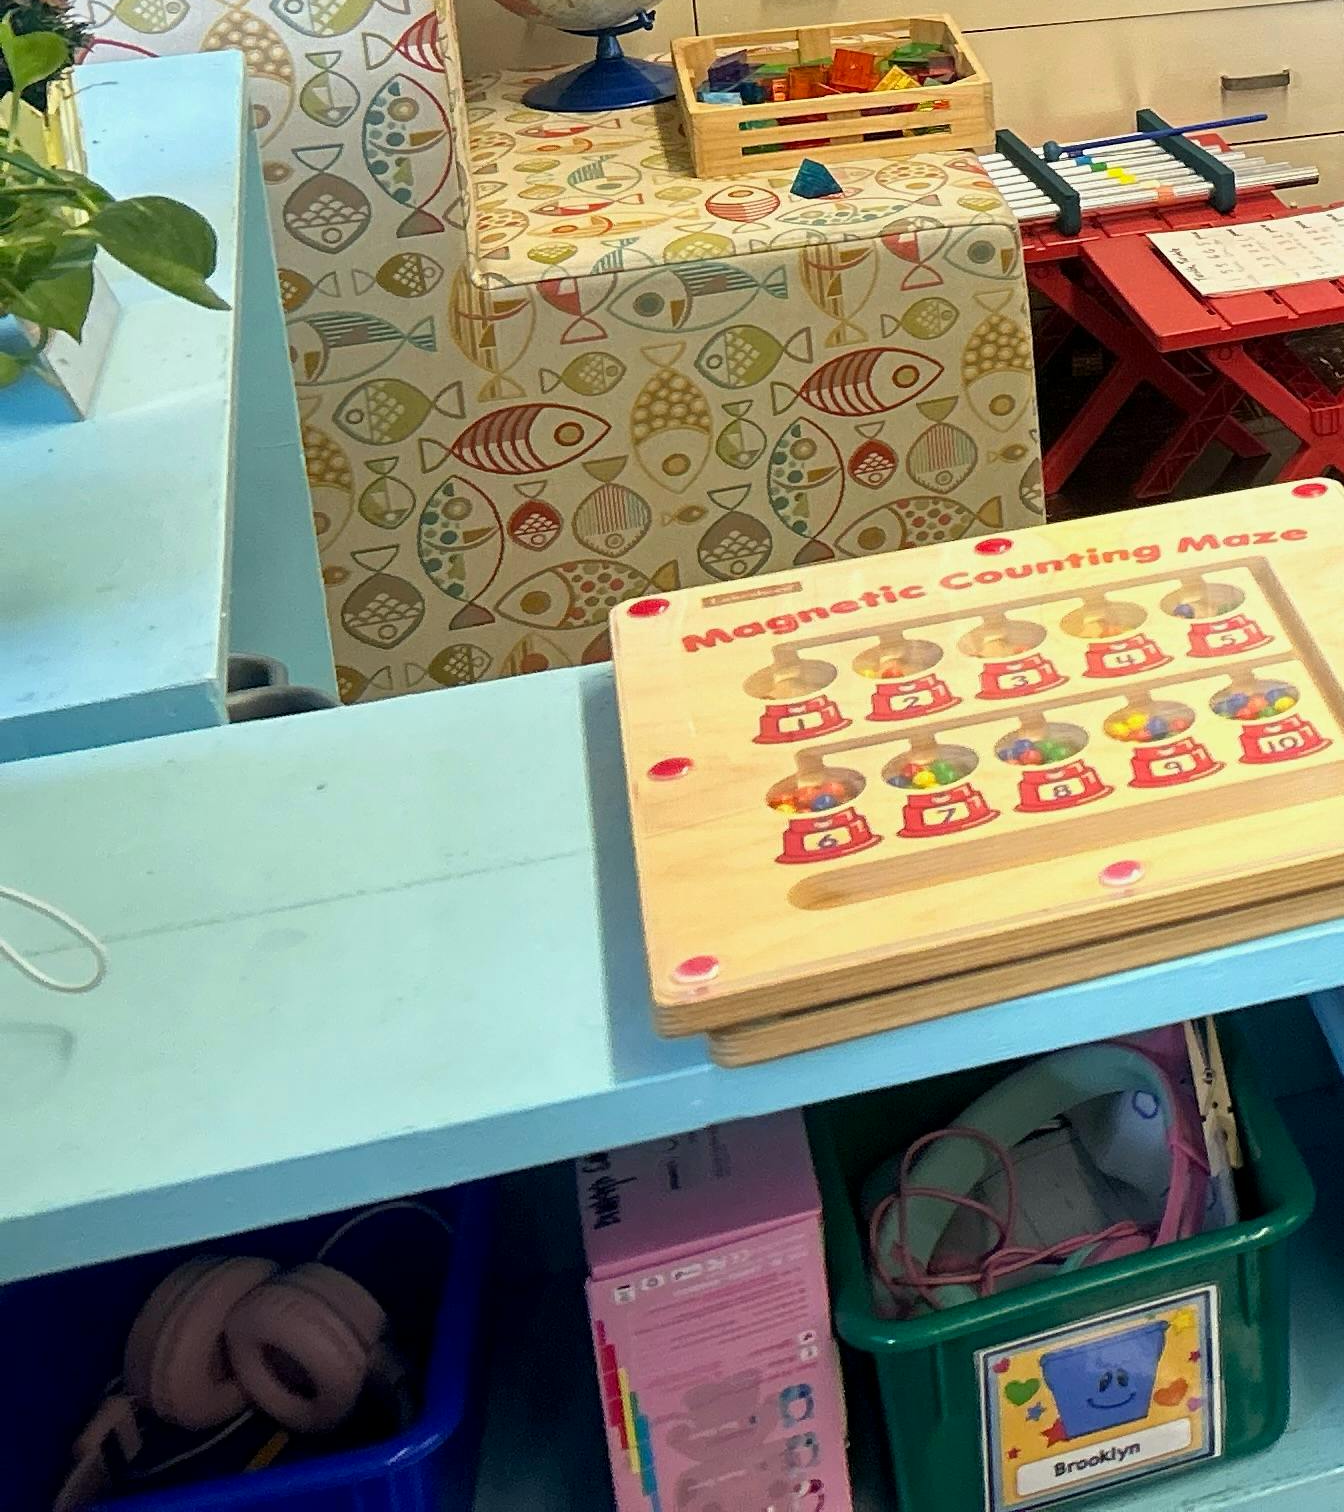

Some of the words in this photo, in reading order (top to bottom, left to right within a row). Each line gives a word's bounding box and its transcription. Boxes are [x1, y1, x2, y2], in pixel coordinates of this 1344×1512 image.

[682, 583, 927, 654] Magnetic
[938, 539, 1164, 593] Counting
[1176, 522, 1310, 556] Maze
[1220, 632, 1238, 649] 5
[1117, 651, 1135, 668] 4
[1012, 673, 1030, 690] 3
[903, 694, 920, 710] 2
[796, 717, 807, 732] 1
[1264, 735, 1299, 754] 10
[1164, 759, 1183, 776] 9
[1053, 782, 1070, 800] 8
[938, 807, 956, 824] 7
[817, 832, 837, 850] 6
[1054, 1442, 1142, 1478] Brooklyn
